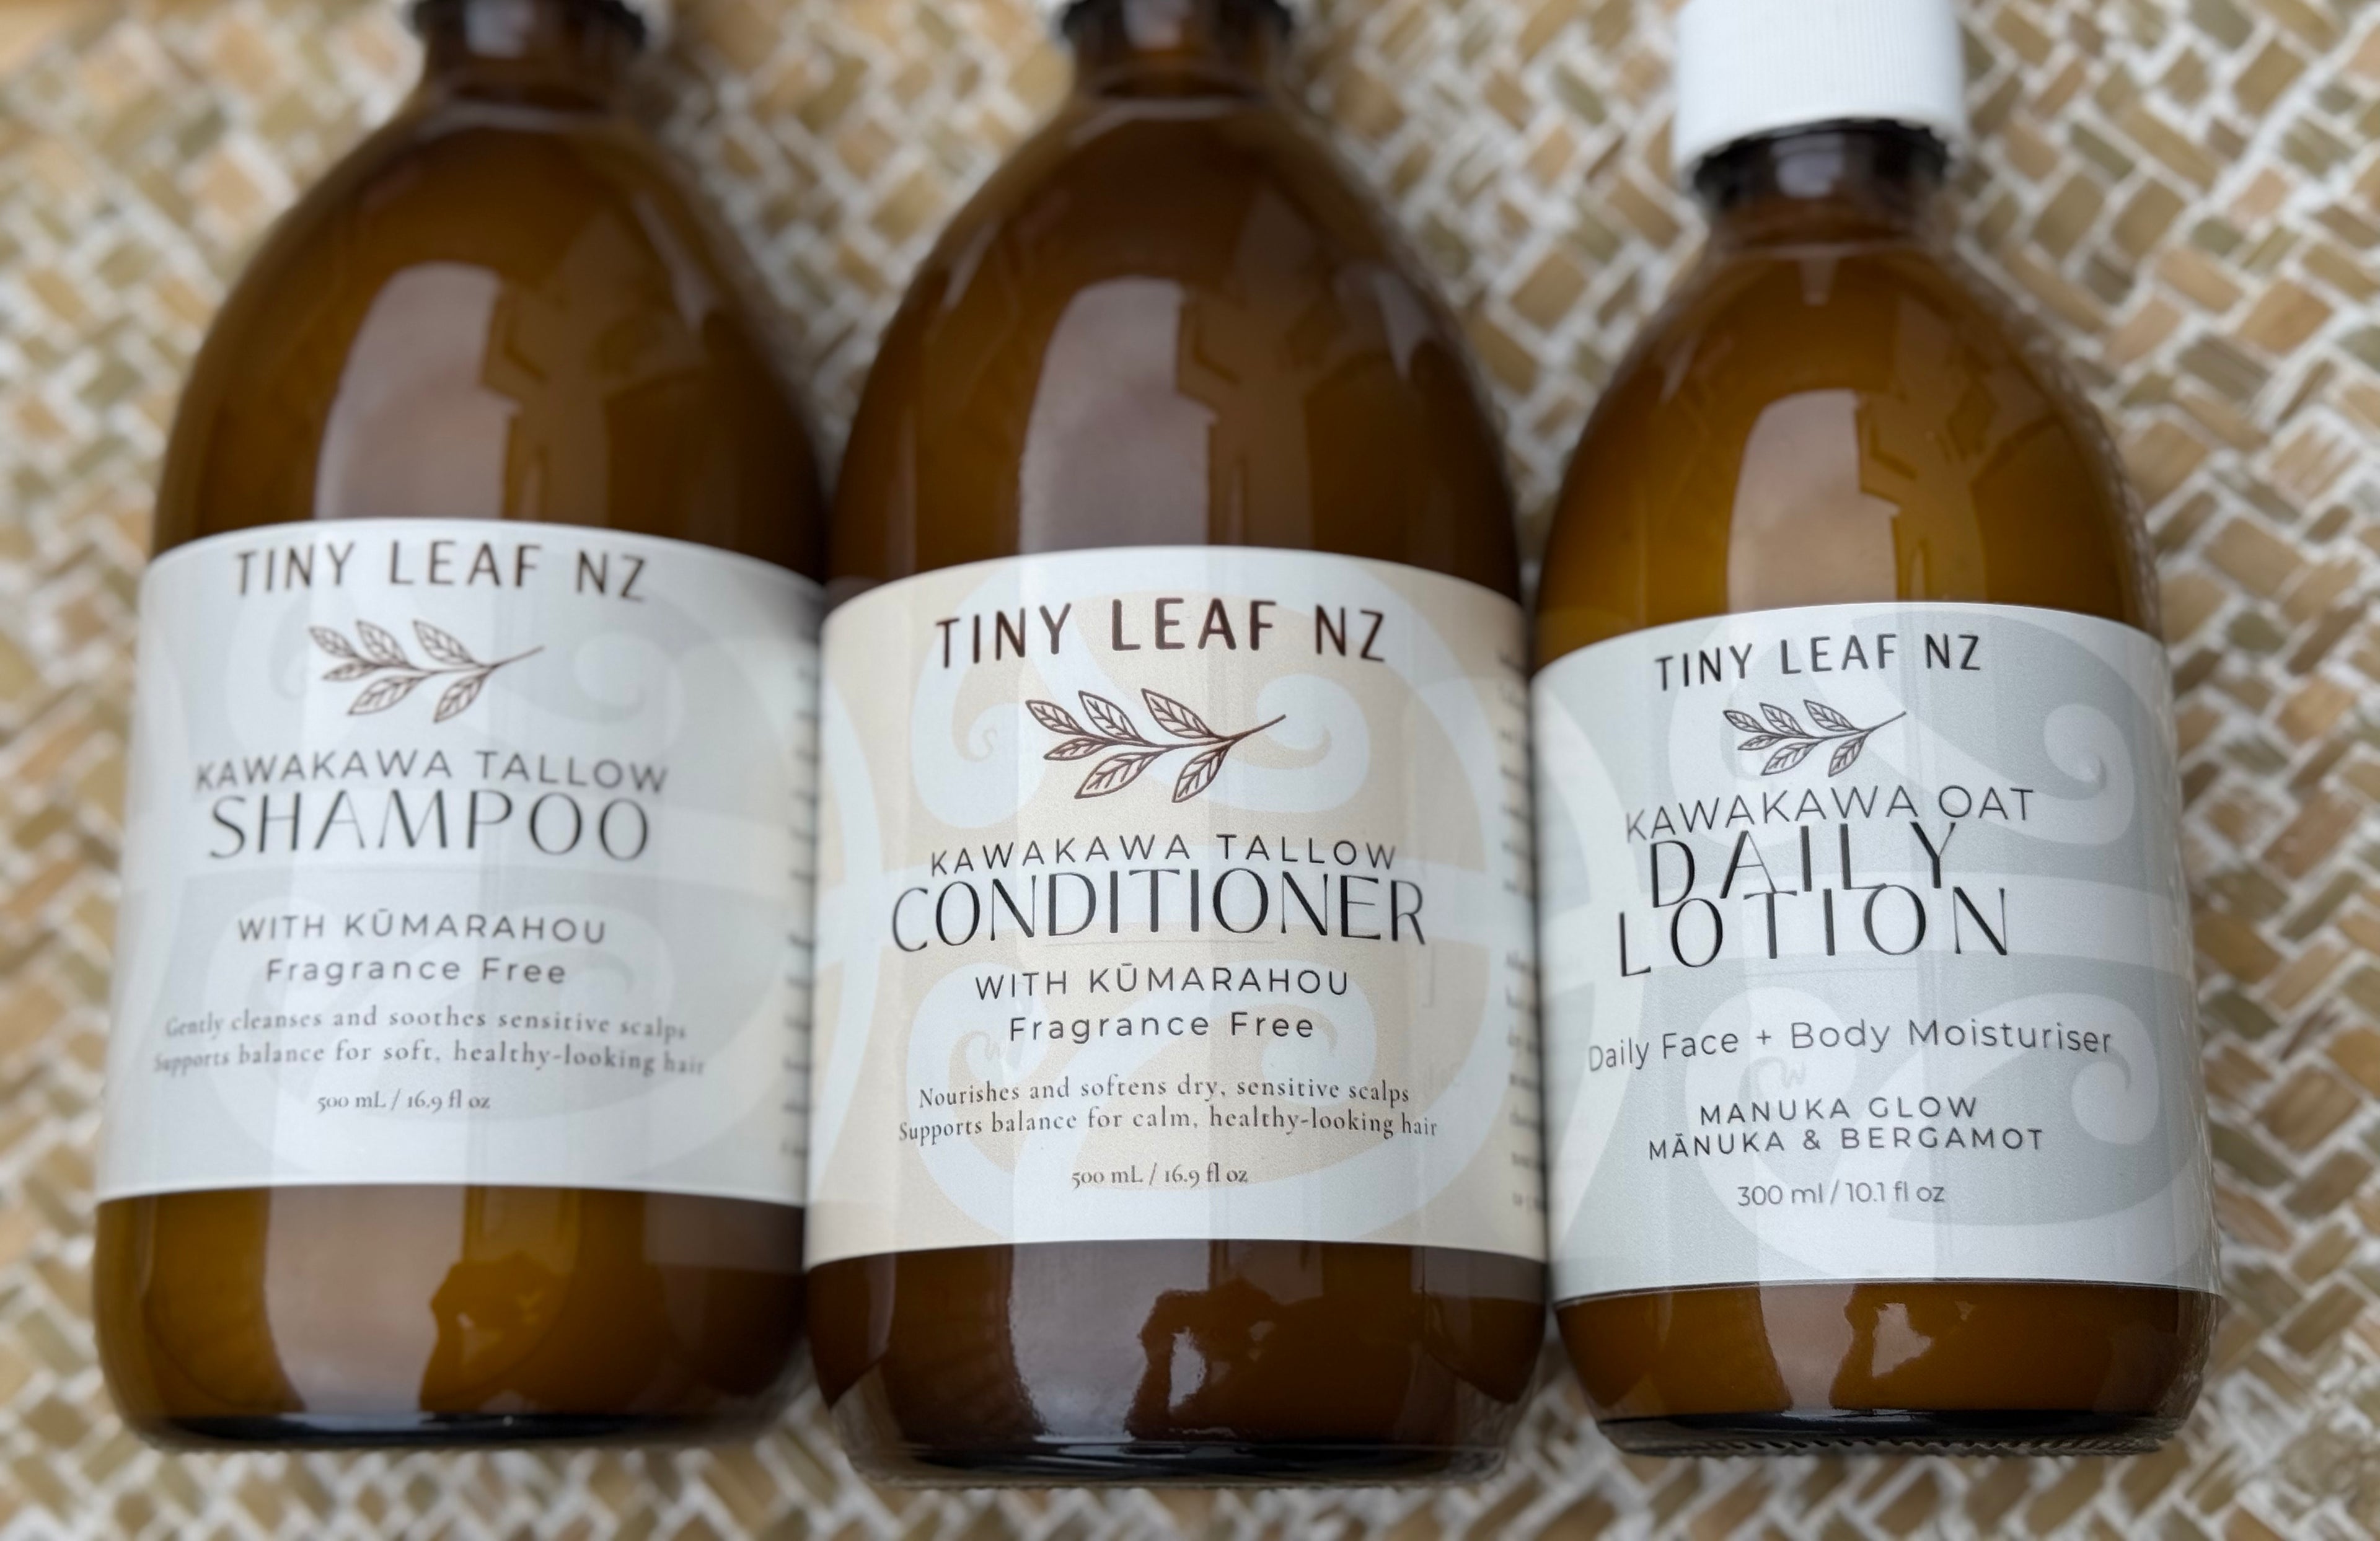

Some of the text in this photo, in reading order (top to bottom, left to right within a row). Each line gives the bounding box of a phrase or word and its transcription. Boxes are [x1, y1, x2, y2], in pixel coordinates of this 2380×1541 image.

[237, 540, 646, 600] TINY LEAF NZ
[935, 597, 1386, 669] TINY LEAF NZ
[1654, 634, 1981, 691] TINY LEAF NZ
[196, 749, 668, 794] KAWAKAWA TALLOW
[209, 789, 648, 861] SHAMPOO
[1626, 785, 2034, 843] KAWAKAWA OAT
[932, 834, 1396, 876] KAWAKAWA TALLOW
[1651, 821, 1957, 908] DAILY
[238, 908, 606, 944] WITH KŪMARAHOU
[892, 867, 1425, 952] CONDITIONER
[1618, 883, 2008, 977] LOTION
[268, 957, 566, 986] Fragrance Free
[976, 963, 1349, 1000] WITH KŪMARAHOU
[165, 1004, 687, 1044] Gently cleanses and soothes sensitive scalps
[1010, 1012, 1314, 1045] Fragrance Free
[154, 1051, 229, 1077] Supports
[239, 1043, 324, 1065] balance
[336, 1039, 371, 1061] for
[454, 1040, 655, 1078] healthy-looking
[663, 1050, 705, 1076] hair
[1589, 1019, 2111, 1072] Daily Face + Body Moisturiser
[317, 1088, 490, 1113] 500 mL / 16.9 fl oz
[920, 1081, 1020, 1108] Nourishes
[1029, 1076, 1069, 1099] and
[1081, 1074, 1166, 1097] softens
[1237, 1078, 1339, 1098] sensitive
[1349, 1079, 1409, 1108] scalps
[899, 1118, 982, 1146] Supports
[992, 1110, 1077, 1133] balance
[1088, 1106, 1122, 1128] for
[1210, 1105, 1393, 1139] healthy-looking
[1402, 1113, 1437, 1135] hair
[1700, 1097, 1978, 1126] MANUKA GLOW
[1649, 1128, 2043, 1161] MĀNUKA & BERGAMOT
[1072, 1162, 1248, 1188] 500 mL / 16.9 fl oz
[1737, 1179, 1945, 1206] 300 ml / 10.1 fl oz
